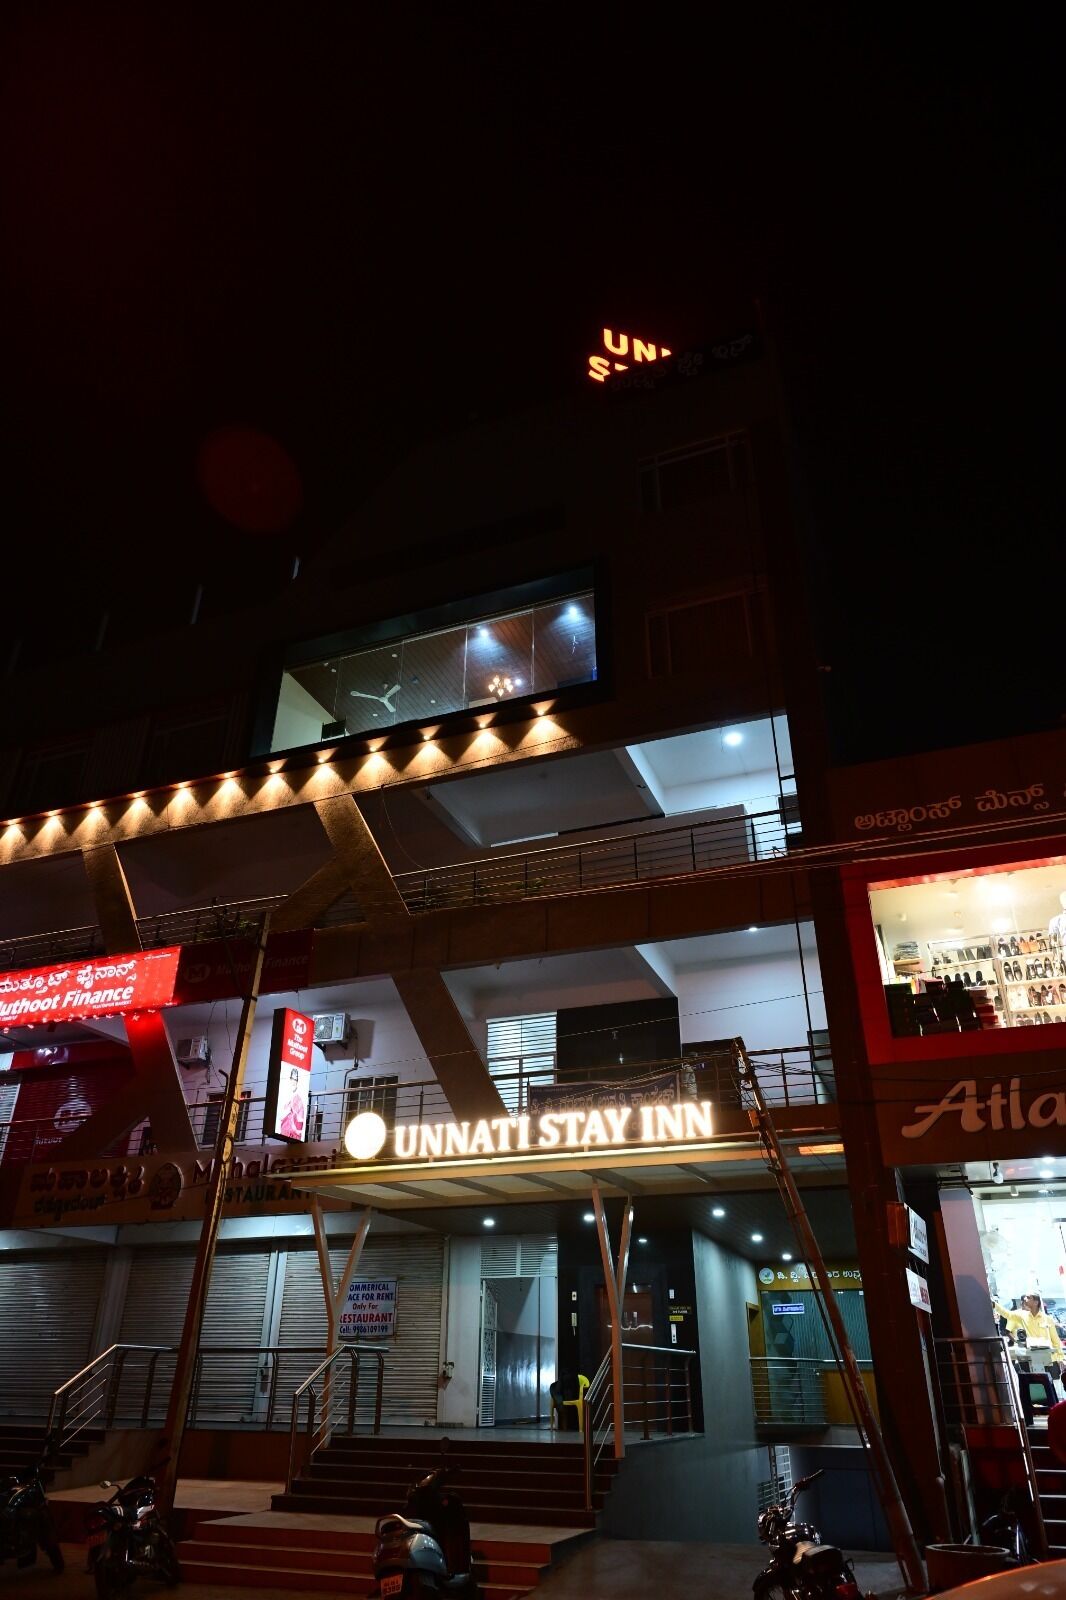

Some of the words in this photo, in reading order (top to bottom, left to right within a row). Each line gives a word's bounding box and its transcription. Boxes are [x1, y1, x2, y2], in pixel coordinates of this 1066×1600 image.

[602, 327, 672, 363] UN
[0, 994, 61, 1017] uthoot
[62, 985, 134, 1008] Finance
[287, 1039, 309, 1054] Muthoot
[289, 1047, 306, 1061] Group
[393, 1116, 531, 1158] UNNATI
[538, 1107, 632, 1148] STAY
[640, 1101, 714, 1141] INN
[192, 1148, 338, 1184] Mhalaxmi
[349, 1283, 389, 1292] OMMERICAL
[346, 1293, 360, 1301] ACE
[361, 1293, 375, 1301] FOR
[376, 1292, 394, 1301] RENT
[352, 1302, 367, 1310] Only
[368, 1302, 379, 1310] For
